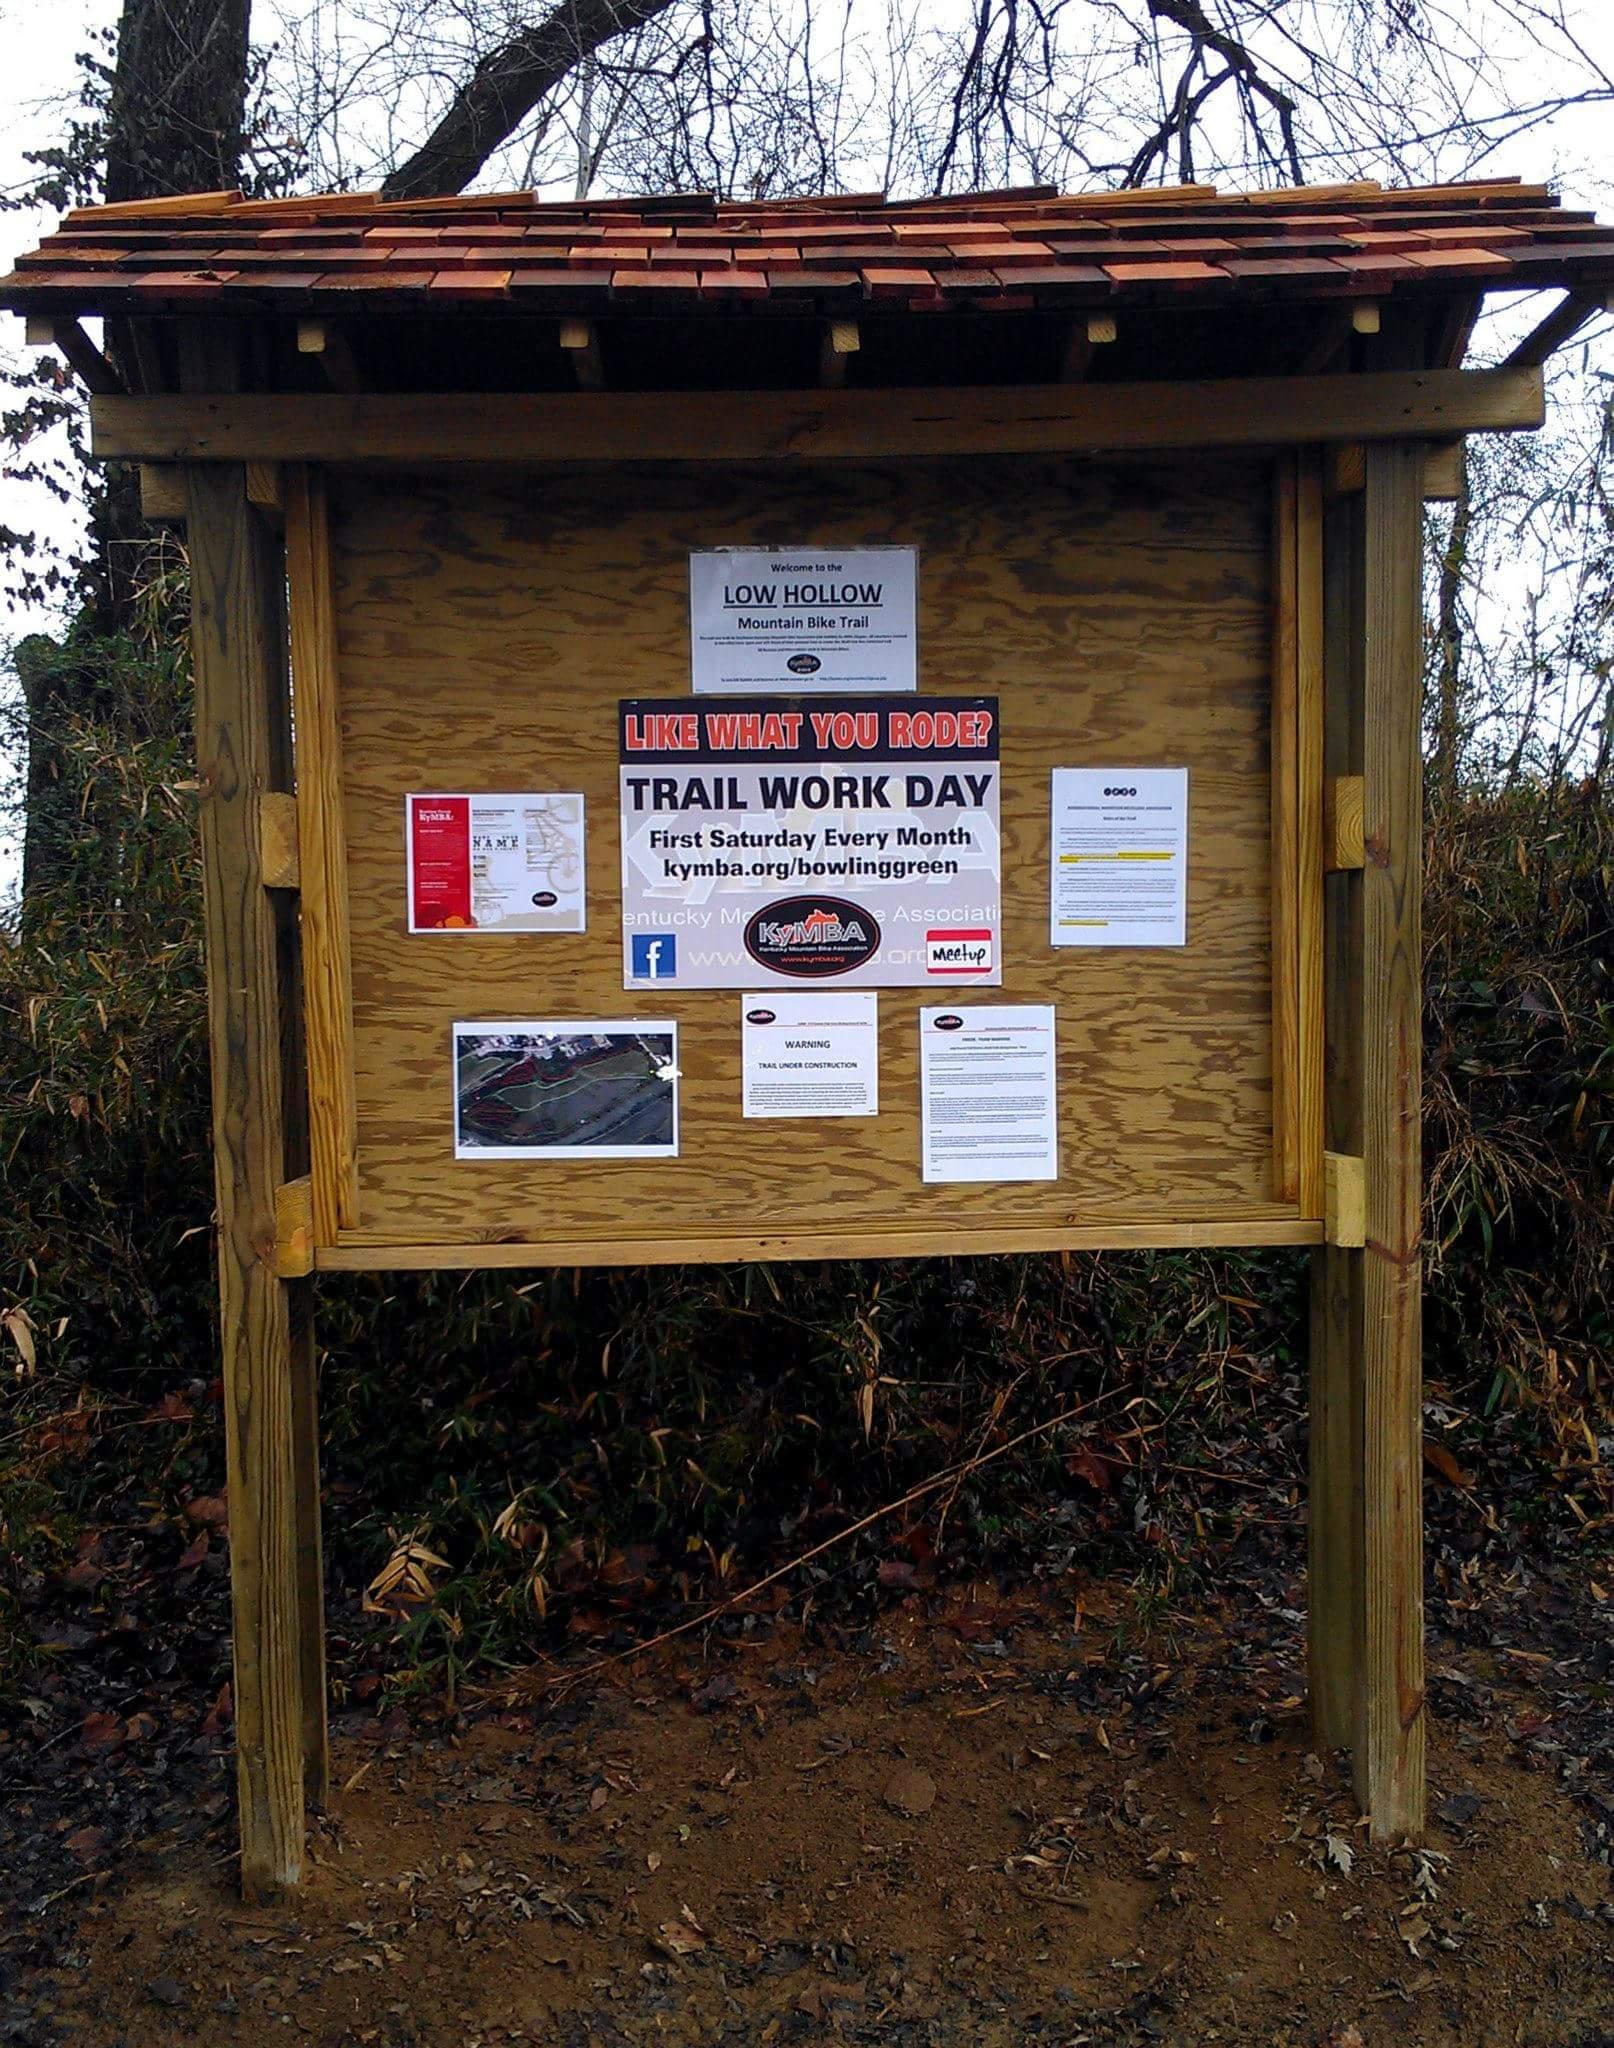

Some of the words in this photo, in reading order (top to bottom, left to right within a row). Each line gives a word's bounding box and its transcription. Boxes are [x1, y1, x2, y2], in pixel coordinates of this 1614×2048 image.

[771, 563, 814, 573] Welcome
[815, 564, 825, 573] to
[827, 563, 843, 572] the
[724, 585, 777, 604] LOW
[784, 584, 882, 604] HOLLOW
[738, 616, 804, 630] Mountain
[808, 616, 836, 629] Bike
[840, 616, 869, 628] Trail
[625, 714, 699, 751] LIKE
[705, 713, 803, 750] WHAT
[810, 712, 879, 750] YOU
[889, 711, 993, 750] RODE?
[626, 777, 747, 811] TRAIL
[759, 775, 892, 810] WORK
[905, 774, 993, 808] DAY
[650, 829, 703, 849] First
[709, 829, 817, 852] Saturday
[824, 828, 889, 851] Every
[897, 826, 972, 847] Month
[663, 856, 959, 880] kymba.org/bowlinggreen
[758, 921, 867, 947] KyMBA
[781, 955, 845, 964] www.kymba.org
[785, 1040, 831, 1049] WARNING
[804, 1061, 858, 1069] CONSTRUCTION
